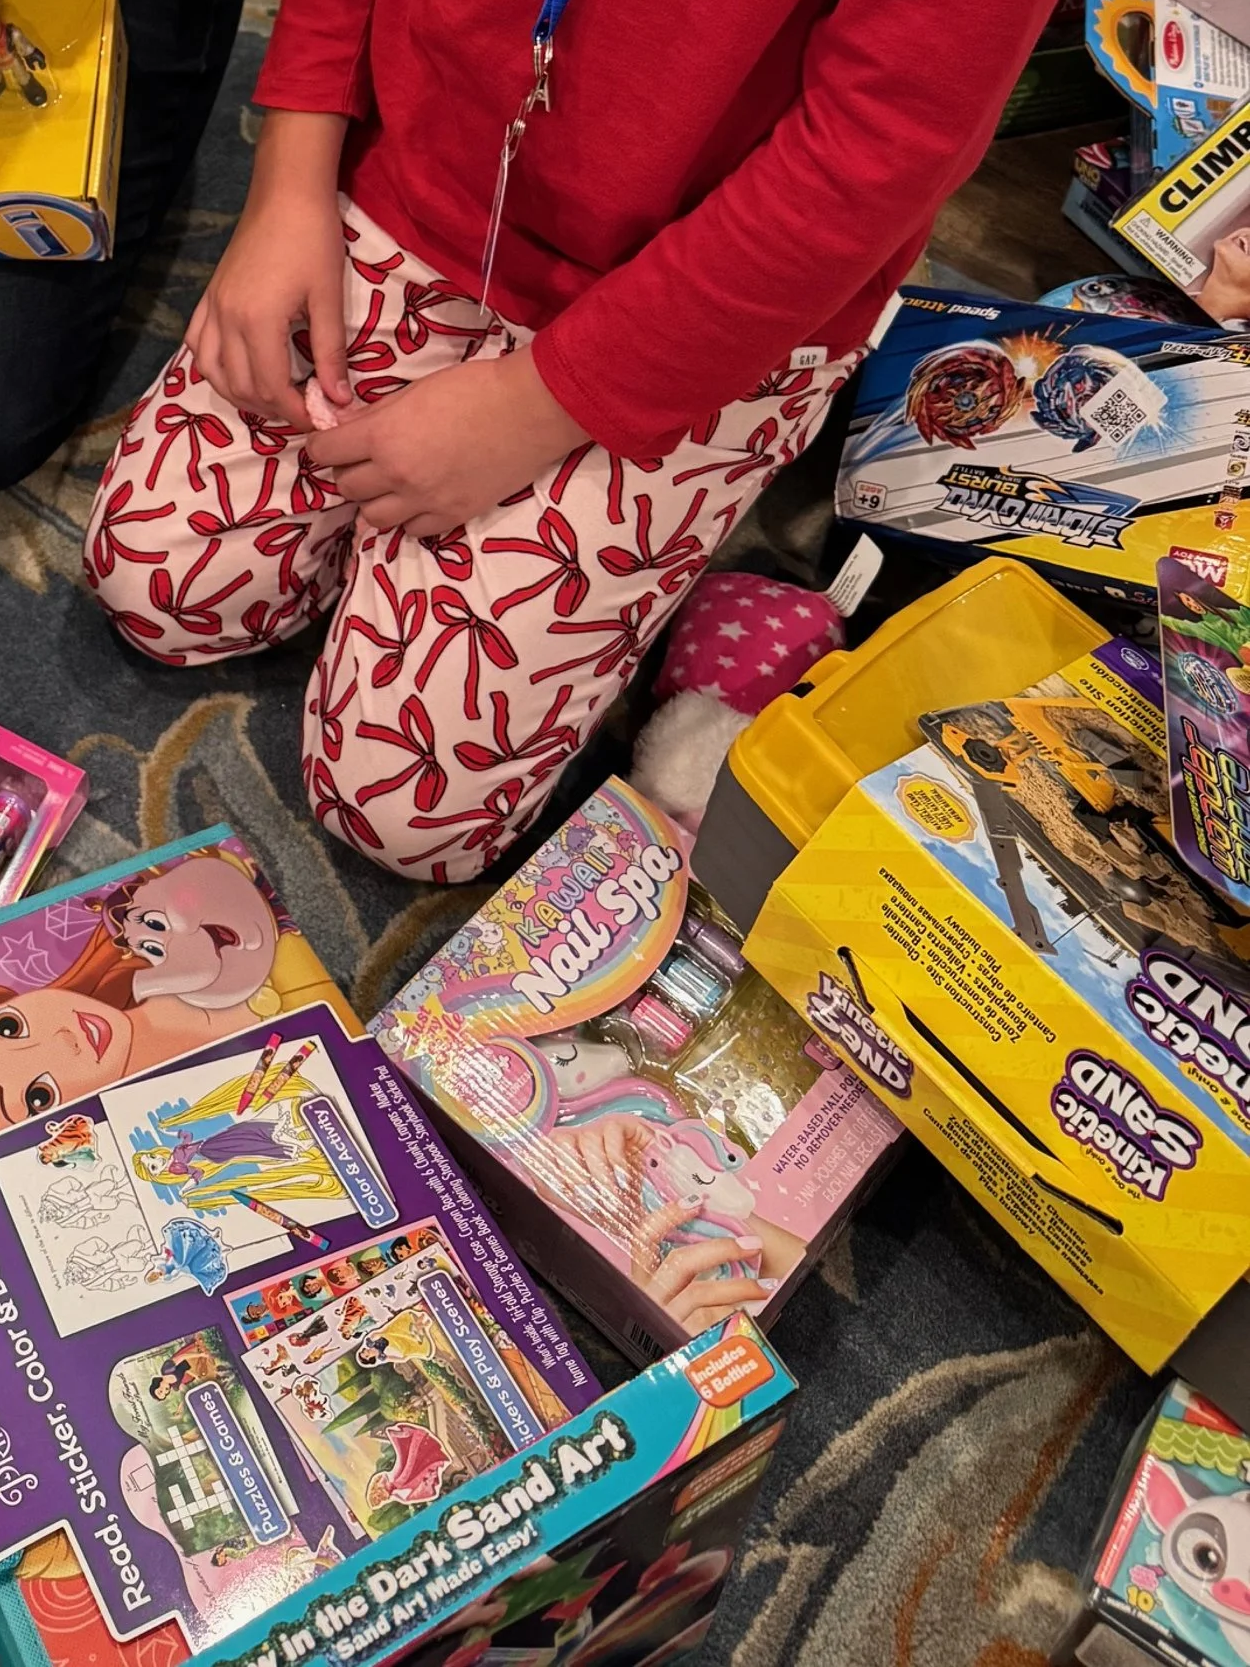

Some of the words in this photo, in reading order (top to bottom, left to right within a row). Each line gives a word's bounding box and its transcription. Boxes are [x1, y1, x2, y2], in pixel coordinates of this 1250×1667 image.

[1154, 227, 1196, 268] WARNING:
[800, 354, 817, 365] GAP
[514, 845, 615, 949] KAWAII
[886, 894, 928, 934] Cantiere
[511, 908, 613, 1014] Nail
[595, 844, 683, 924] Spa
[877, 902, 923, 946] Baustelle
[879, 920, 922, 962] Chantier
[922, 963, 946, 986] Site
[923, 947, 987, 1008] construcción
[974, 962, 1005, 992] obras
[939, 981, 1004, 1042] Construction
[969, 975, 1029, 1032] Bouwplaats
[981, 1003, 998, 1020] de
[1000, 987, 1017, 1004] de
[992, 1016, 1021, 1043] Zona
[1012, 999, 1058, 1043] Canteiro
[373, 1062, 391, 1081] Pad
[382, 1076, 407, 1105] Sticker
[314, 1107, 351, 1163] Activity
[397, 1099, 431, 1141] Storybook
[772, 1111, 823, 1174] WATER-BASED
[821, 1092, 843, 1117] NAIL
[840, 1073, 858, 1093] POL
[422, 1138, 457, 1182] Storybook
[793, 1154, 810, 1171] NO
[807, 1112, 843, 1155] REMOVER
[357, 1181, 386, 1218] Color
[446, 1176, 476, 1212] Coloring
[469, 1212, 491, 1237] Book
[482, 1233, 509, 1265] Games
[430, 1278, 472, 1335] Scenes
[505, 1269, 534, 1305] Puzzles
[528, 1303, 550, 1326] Clip
[539, 1322, 560, 1345] with
[7, 1329, 54, 1402] Color
[463, 1336, 495, 1377] Play
[551, 1340, 573, 1361] Tag
[690, 1345, 747, 1384] Includes
[561, 1357, 588, 1388] Name
[699, 1384, 713, 1399] 6
[710, 1358, 759, 1393] Bottles
[199, 1389, 236, 1452] Games
[46, 1402, 107, 1514] Sticker,
[238, 1466, 278, 1535] Puzzles
[280, 1632, 317, 1662] in
[316, 1594, 369, 1637] the
[367, 1537, 453, 1605] Dark
[448, 1471, 556, 1550] Sand
[557, 1418, 629, 1481] Art
[94, 1513, 152, 1612] Read,
[337, 1617, 392, 1662] Sand
[391, 1596, 428, 1636] Art
[425, 1564, 483, 1610] Made
[483, 1520, 540, 1575] Easy!
[1126, 1585, 1156, 1614] 10
